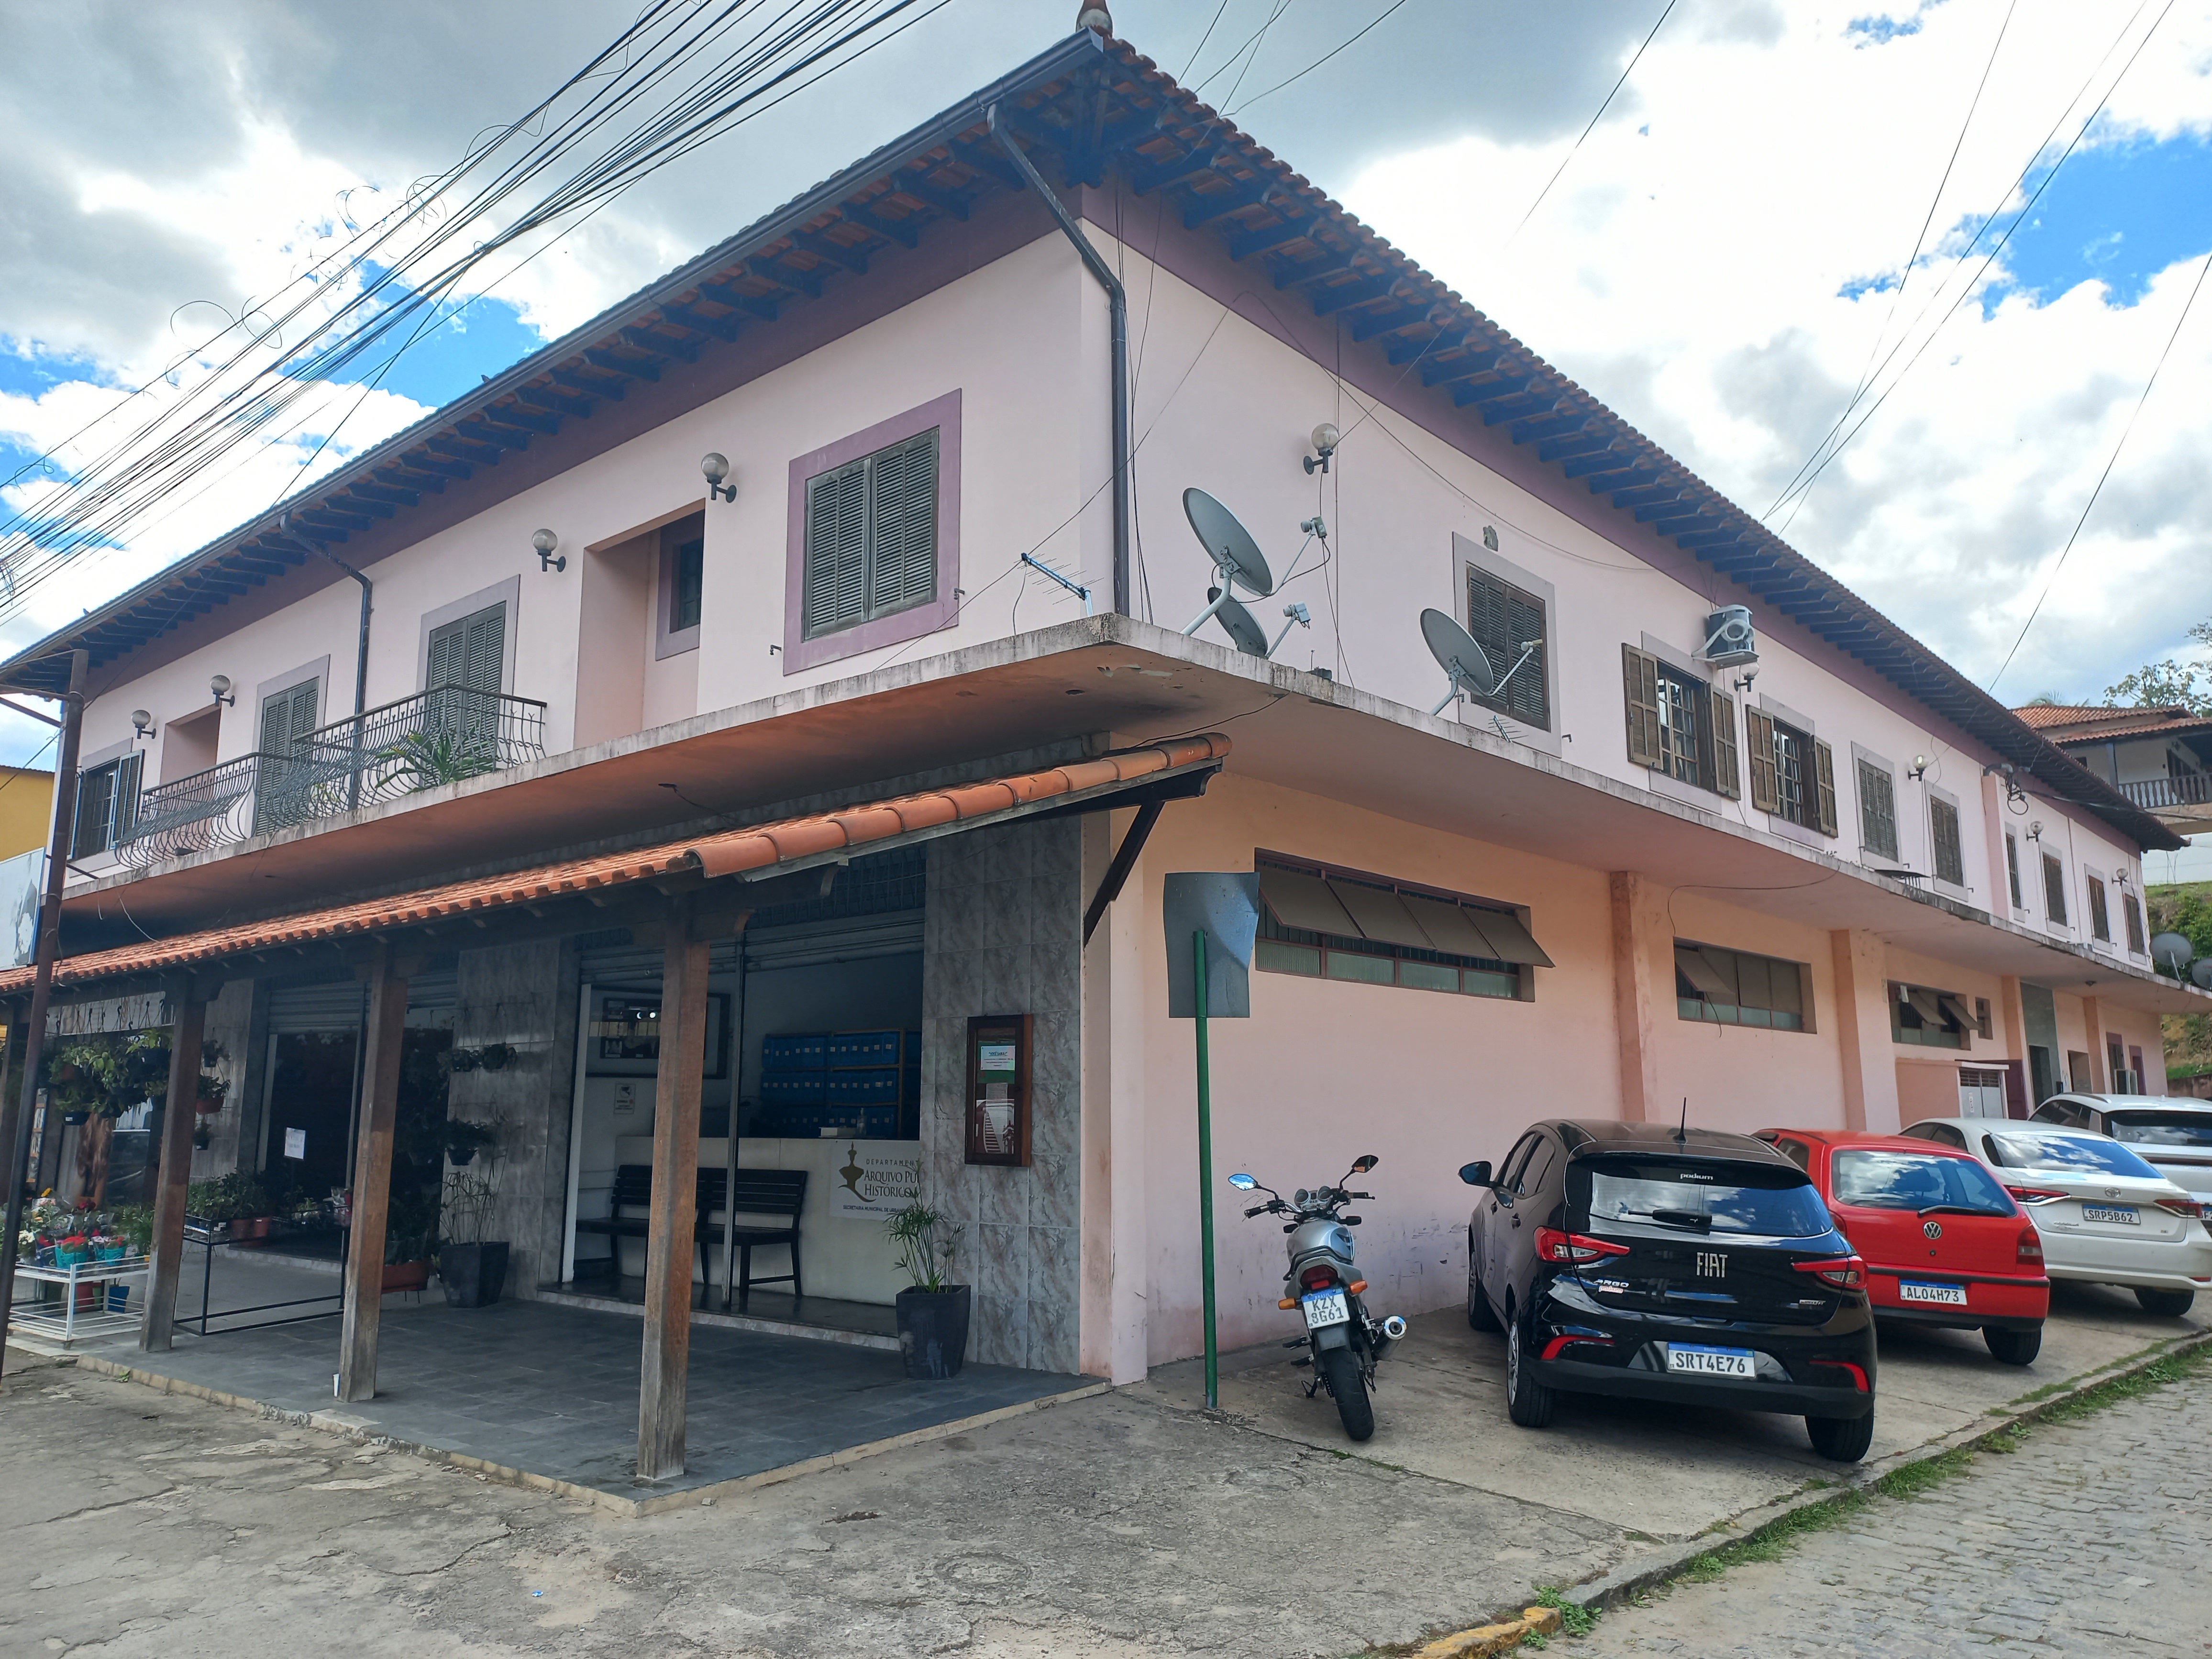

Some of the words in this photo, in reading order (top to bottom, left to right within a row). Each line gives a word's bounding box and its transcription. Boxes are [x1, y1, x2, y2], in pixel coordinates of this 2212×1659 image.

[864, 1170, 903, 1184] ARQUIVO
[864, 1183, 912, 1198] HISTÓRICO
[2089, 1209, 2133, 1222] SRP5B62
[1696, 1252, 1728, 1278] FIAT
[1593, 1279, 1629, 1287] ARGO
[1907, 1287, 1959, 1302] ALO4H73
[1313, 1295, 1337, 1312] KZX
[1311, 1307, 1344, 1324] 8G61
[1676, 1352, 1746, 1373] SRT4E76
